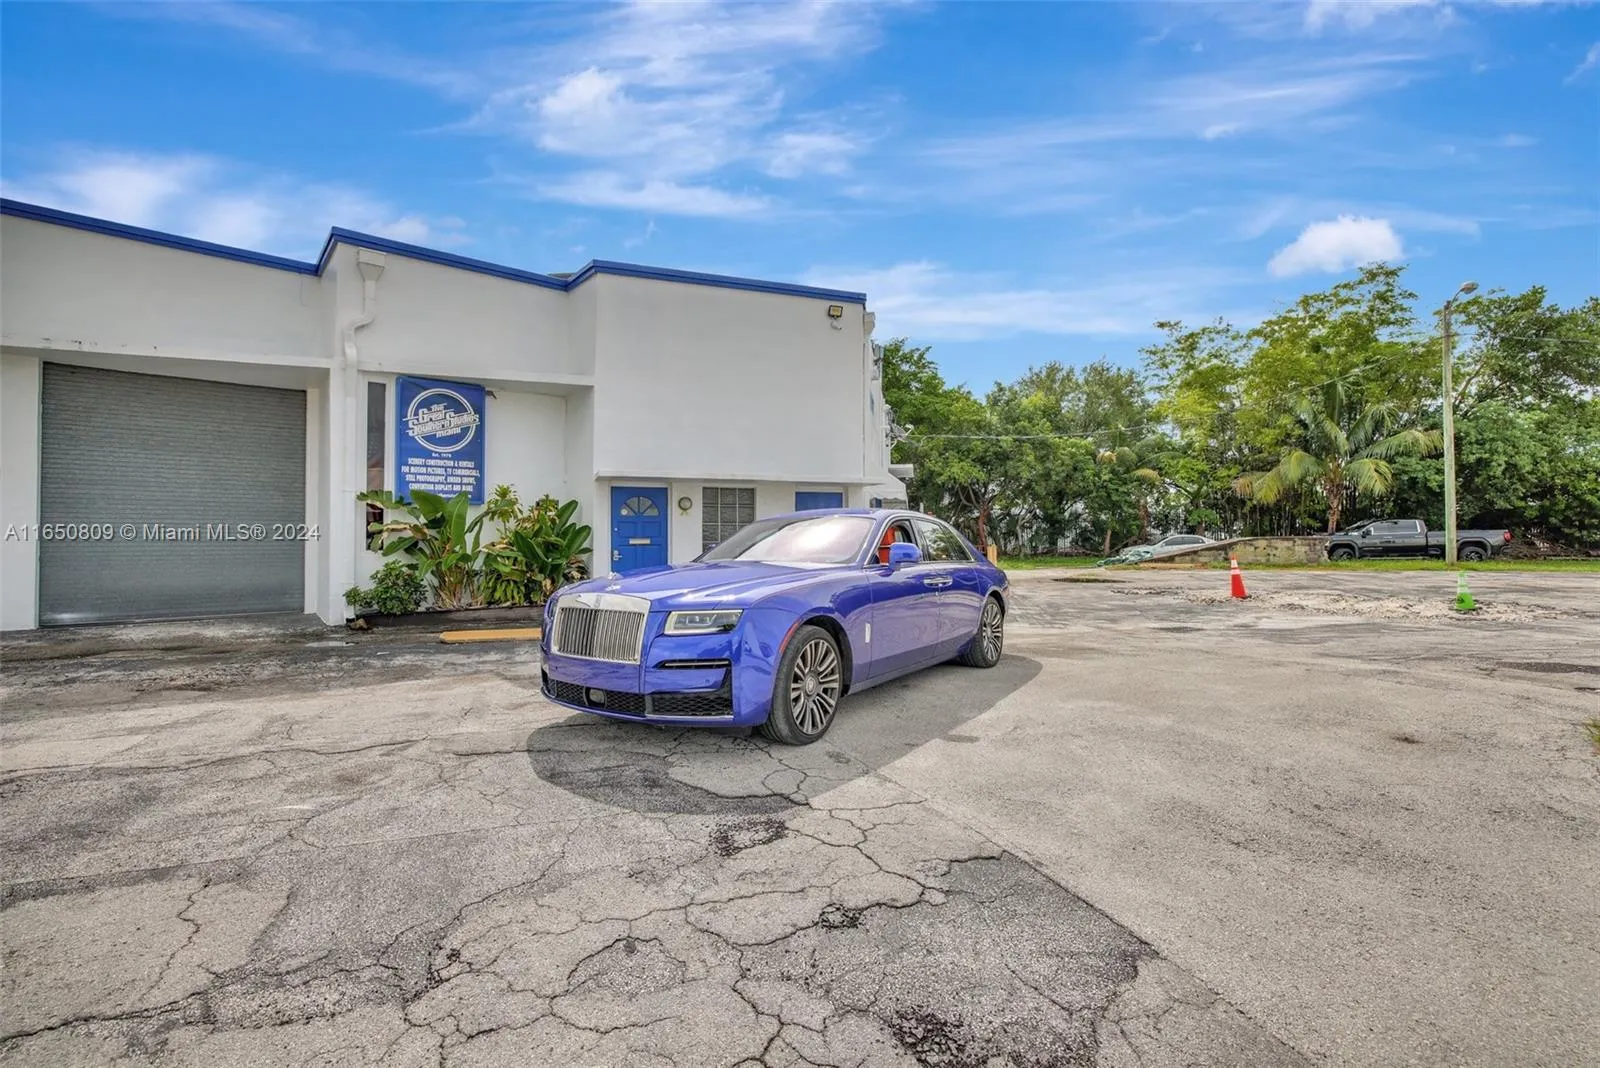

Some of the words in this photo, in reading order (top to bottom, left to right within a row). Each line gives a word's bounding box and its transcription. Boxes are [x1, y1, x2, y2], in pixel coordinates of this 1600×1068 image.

[431, 403, 446, 411] The
[419, 408, 449, 423] Great
[408, 419, 450, 437] Southern
[401, 465, 409, 473] FOR
[411, 466, 426, 474] MOTION
